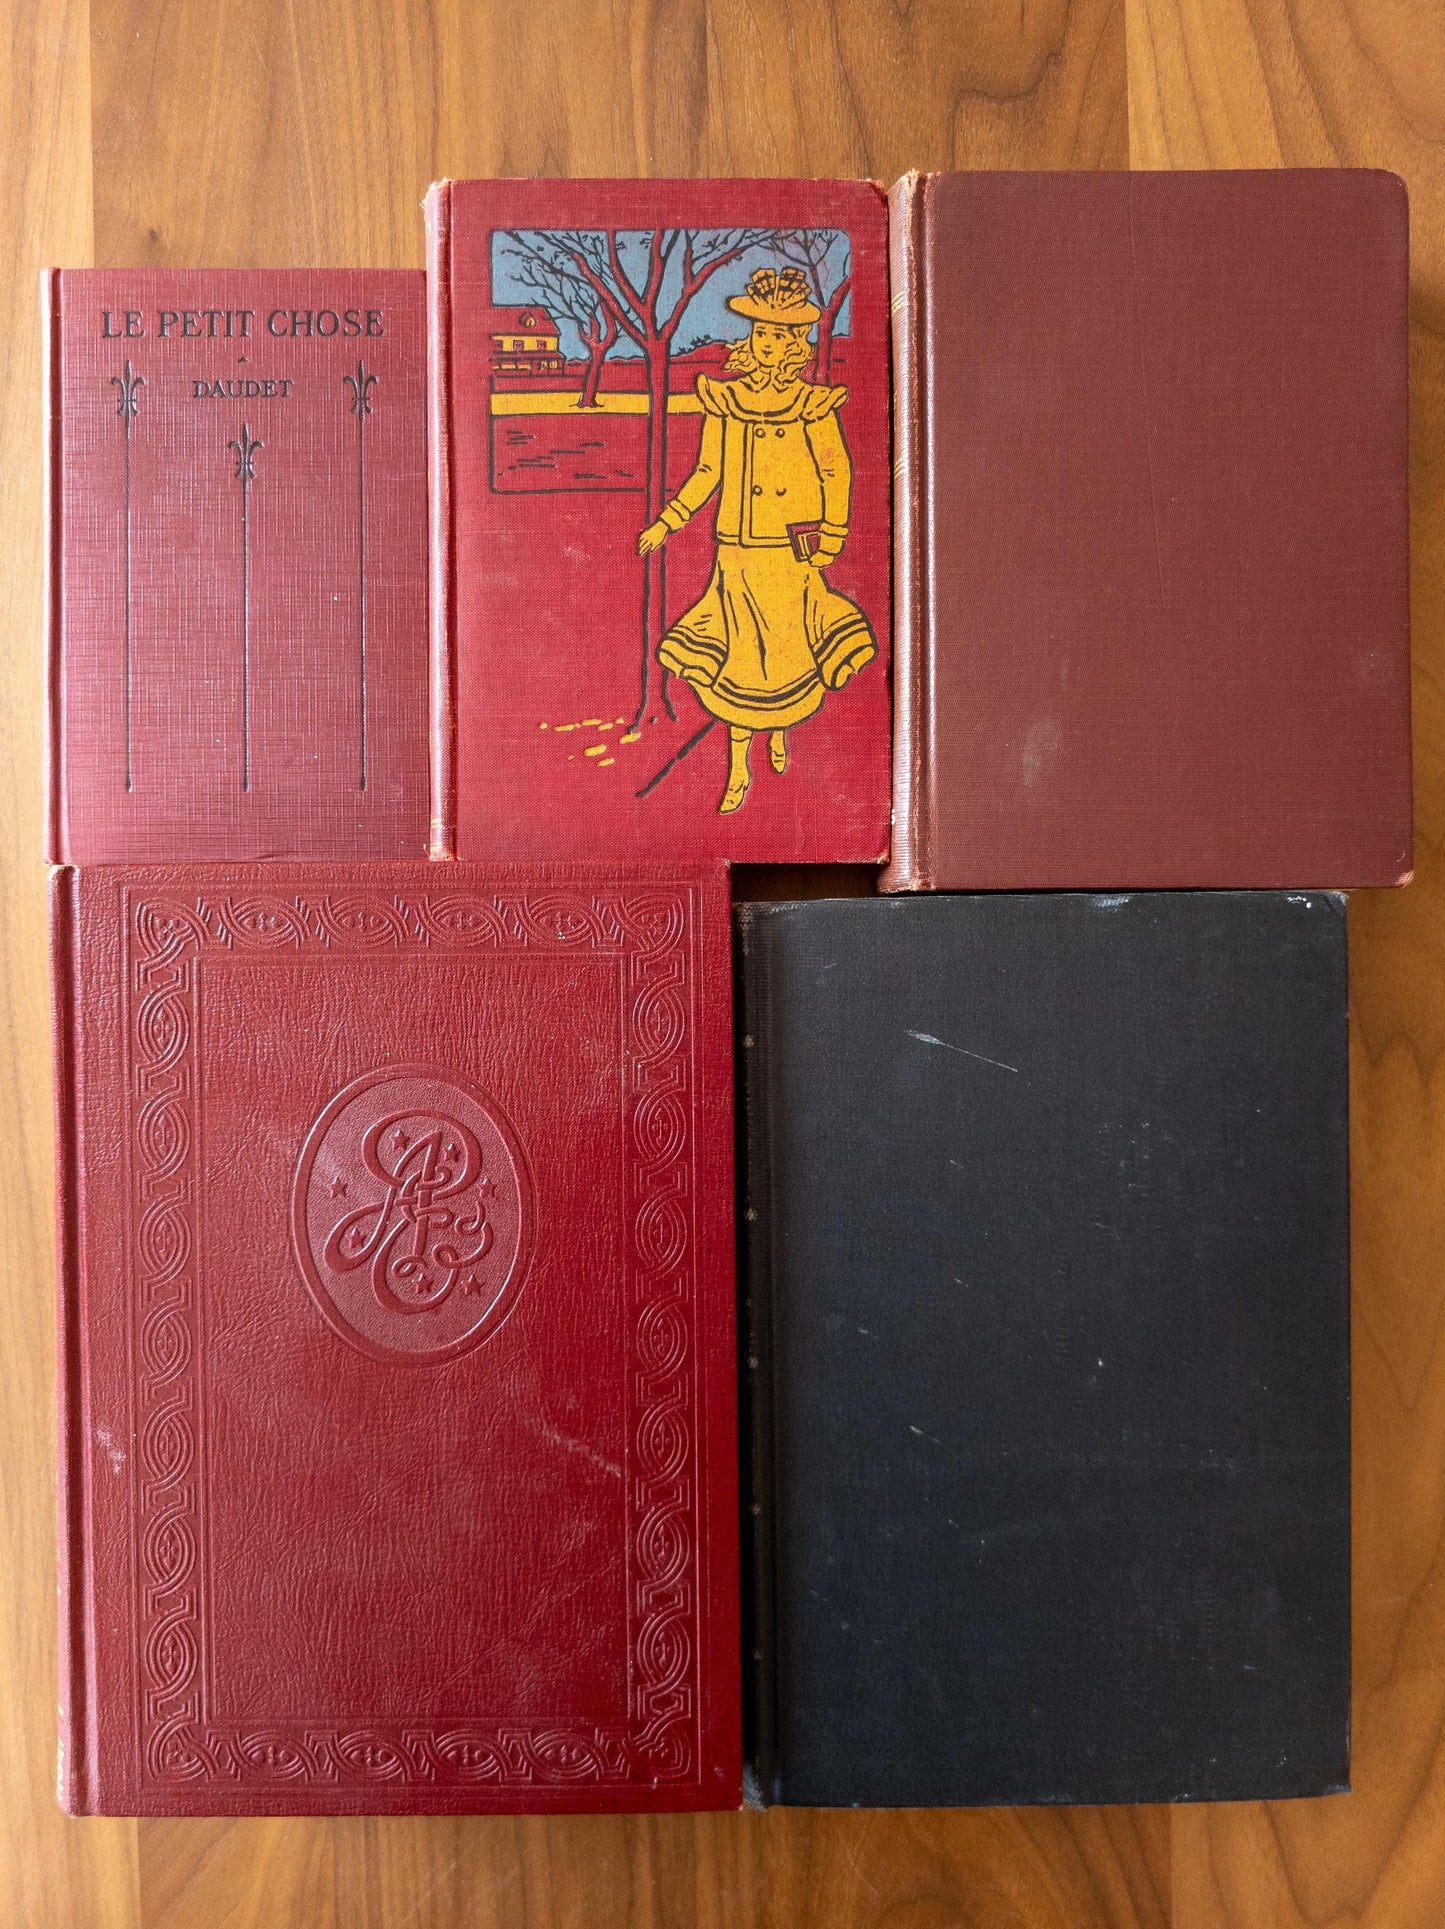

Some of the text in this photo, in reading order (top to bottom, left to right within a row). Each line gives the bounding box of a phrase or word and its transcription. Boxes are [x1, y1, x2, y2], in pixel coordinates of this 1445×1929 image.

[102, 309, 385, 339] LE PETIT CHOSE
[192, 379, 294, 399] DAUDET
